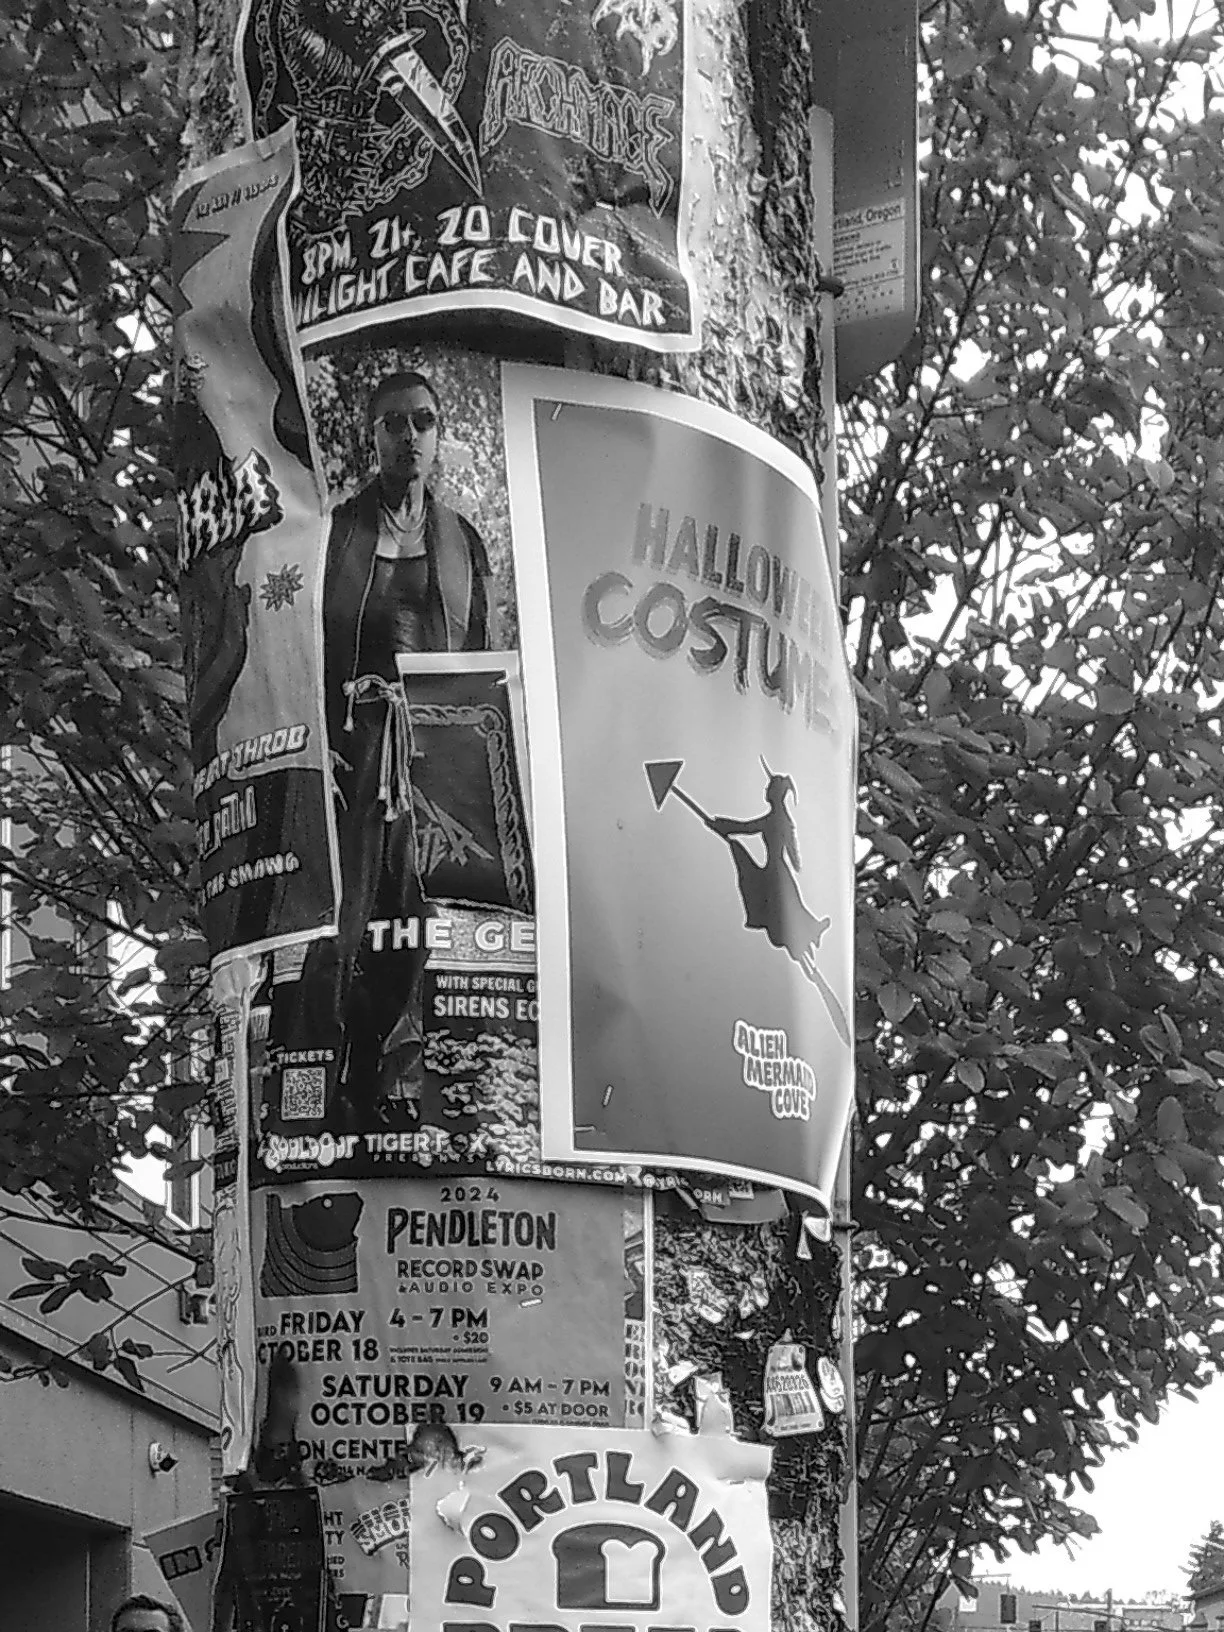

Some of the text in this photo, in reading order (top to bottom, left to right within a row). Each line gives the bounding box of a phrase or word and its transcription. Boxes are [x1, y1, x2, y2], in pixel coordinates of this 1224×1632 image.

[509, 207, 624, 277] COVER
[405, 248, 496, 293] CAFE
[512, 252, 584, 301] AND
[598, 276, 665, 327] BAR
[367, 917, 451, 951] THE
[436, 975, 524, 993] WITH SPECIAL
[434, 995, 510, 1019] SIRENS
[737, 1025, 785, 1060] ALIEN
[276, 1049, 334, 1064] TICKETS
[775, 1088, 808, 1118] COVE
[364, 1133, 429, 1152] TIGER
[440, 1186, 500, 1203] 2024
[387, 1208, 557, 1254] PENDLETON
[397, 1259, 544, 1281] RECORD SWAP
[487, 1282, 544, 1296] EXPO
[280, 1308, 488, 1335] FRIDAY 4 7 PM
[257, 1338, 379, 1364] CTOBER 18
[322, 1374, 610, 1398] SATURDAY 9 AM 7 PM
[311, 1402, 446, 1425] OCTOBER
[457, 1402, 485, 1424] 19
[513, 1400, 532, 1417] $5
[537, 1402, 558, 1416] AT
[560, 1403, 609, 1418] DOOR
[331, 1440, 407, 1459] CENTE
[445, 1451, 749, 1615] PORTLAND
